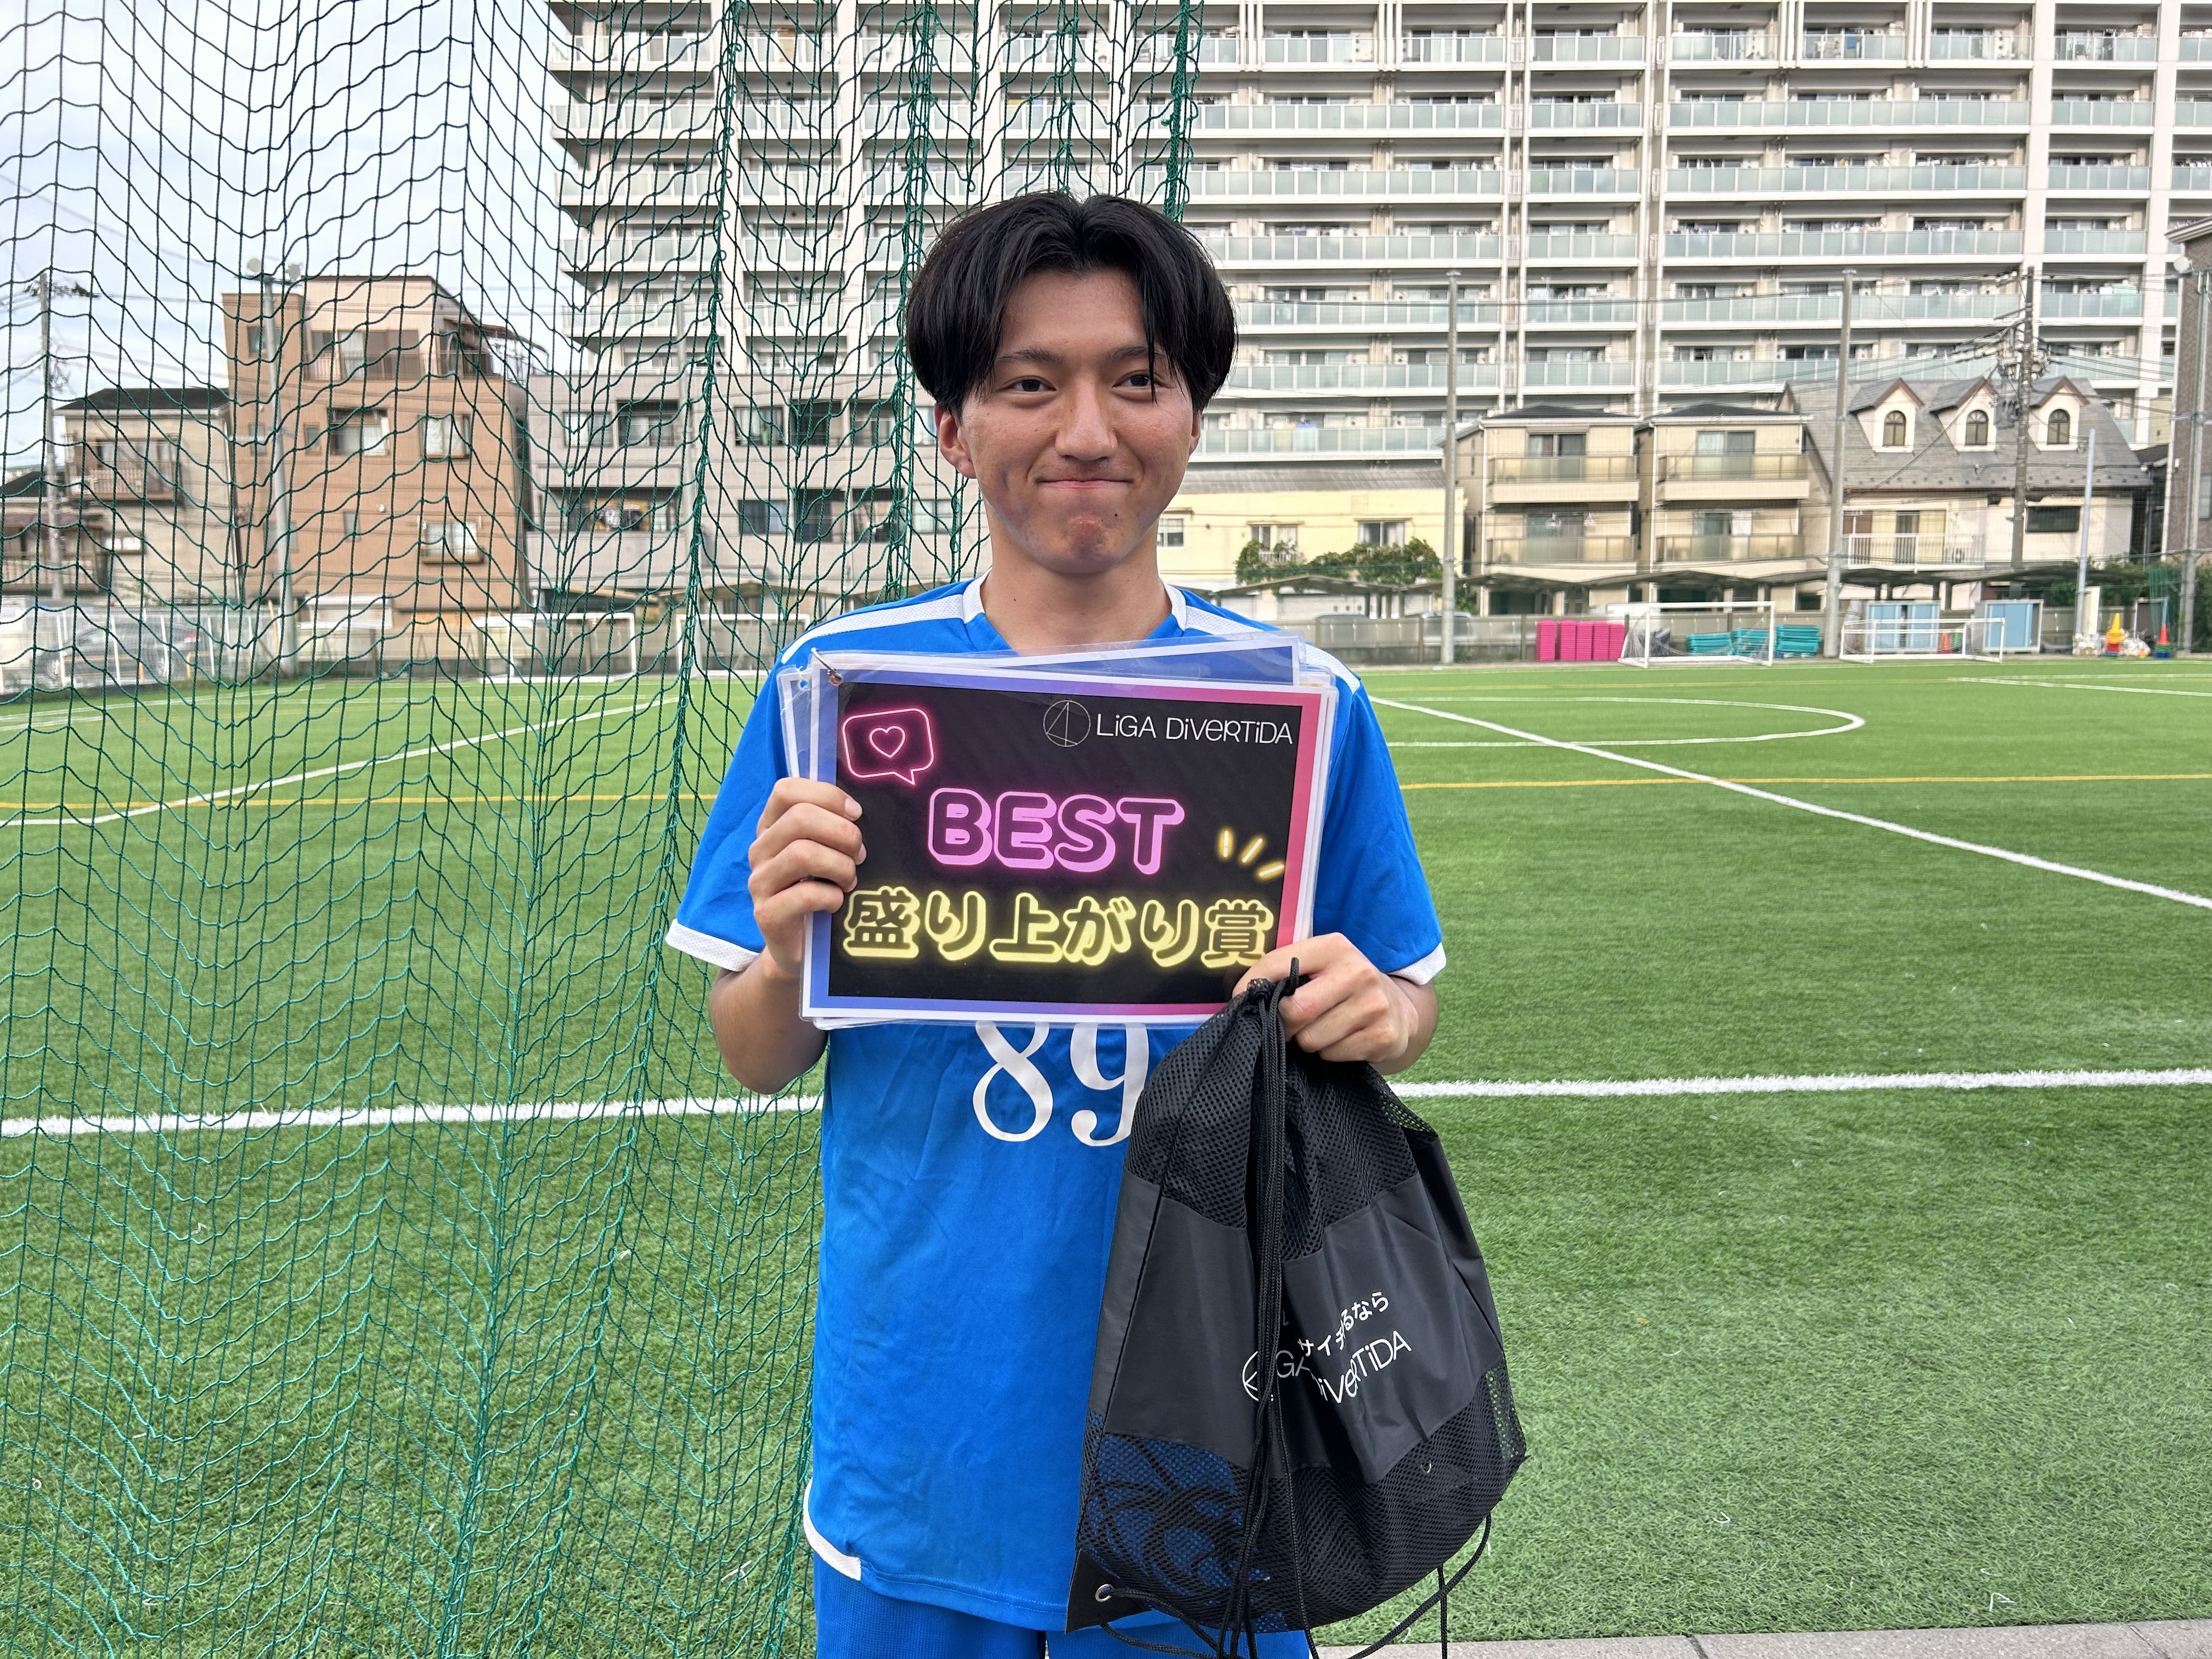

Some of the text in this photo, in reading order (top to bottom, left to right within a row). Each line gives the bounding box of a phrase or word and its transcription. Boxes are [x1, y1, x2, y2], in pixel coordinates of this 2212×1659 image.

[928, 787, 1185, 875] BEST
[843, 885, 1274, 969] 盛り上がり賞
[972, 1020, 1150, 1147] 89
